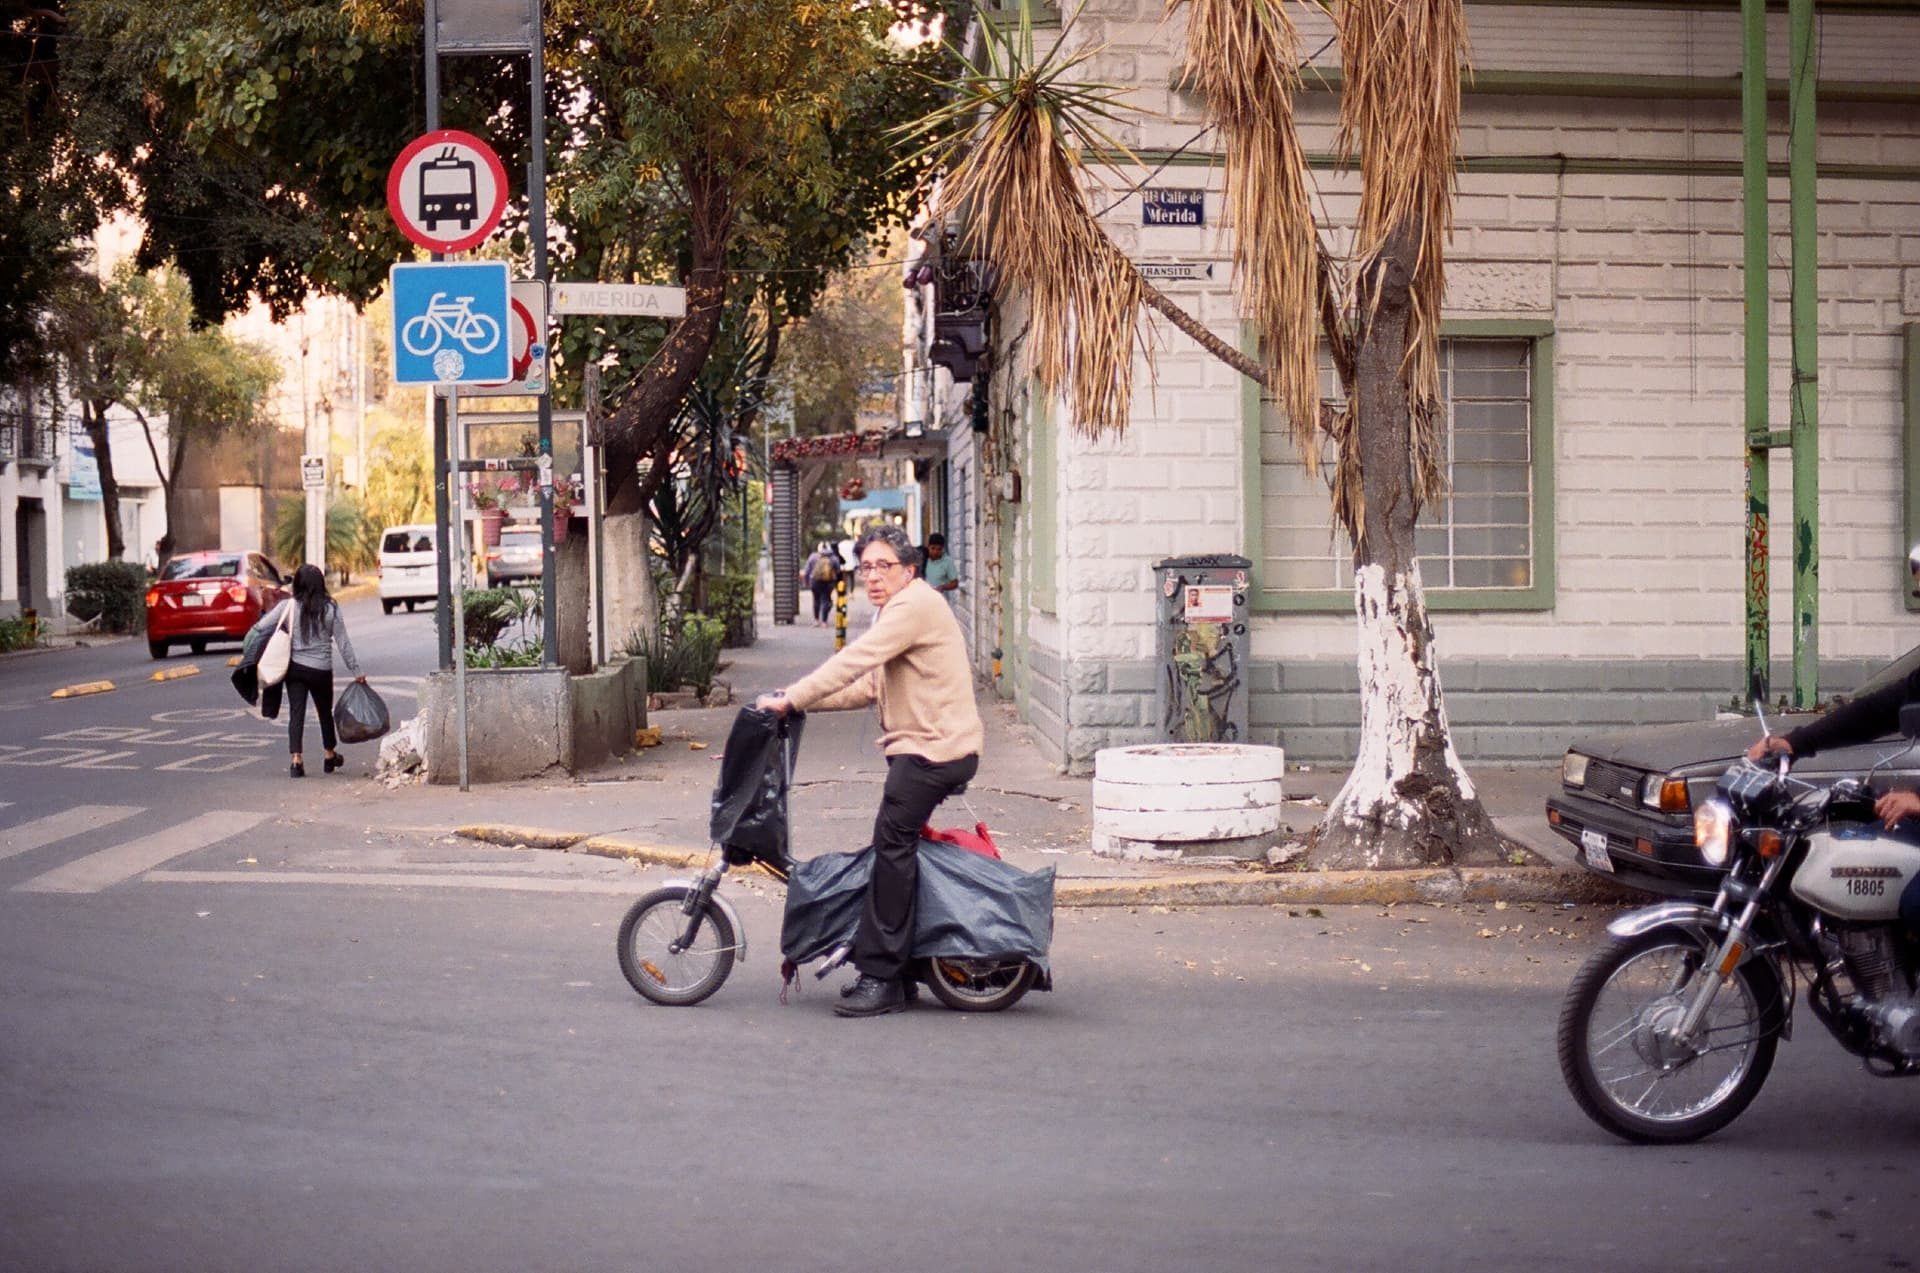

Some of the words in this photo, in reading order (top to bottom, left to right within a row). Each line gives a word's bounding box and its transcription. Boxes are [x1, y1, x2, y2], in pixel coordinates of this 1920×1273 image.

[1161, 191, 1187, 204] Calle
[1190, 191, 1202, 204] de
[1146, 205, 1197, 222] Mérida
[1141, 267, 1191, 276] TRANSITO
[580, 290, 659, 309] MERIDA
[40, 726, 289, 748] BUS
[0, 746, 272, 773] OLO
[1846, 879, 1885, 896] 18805
